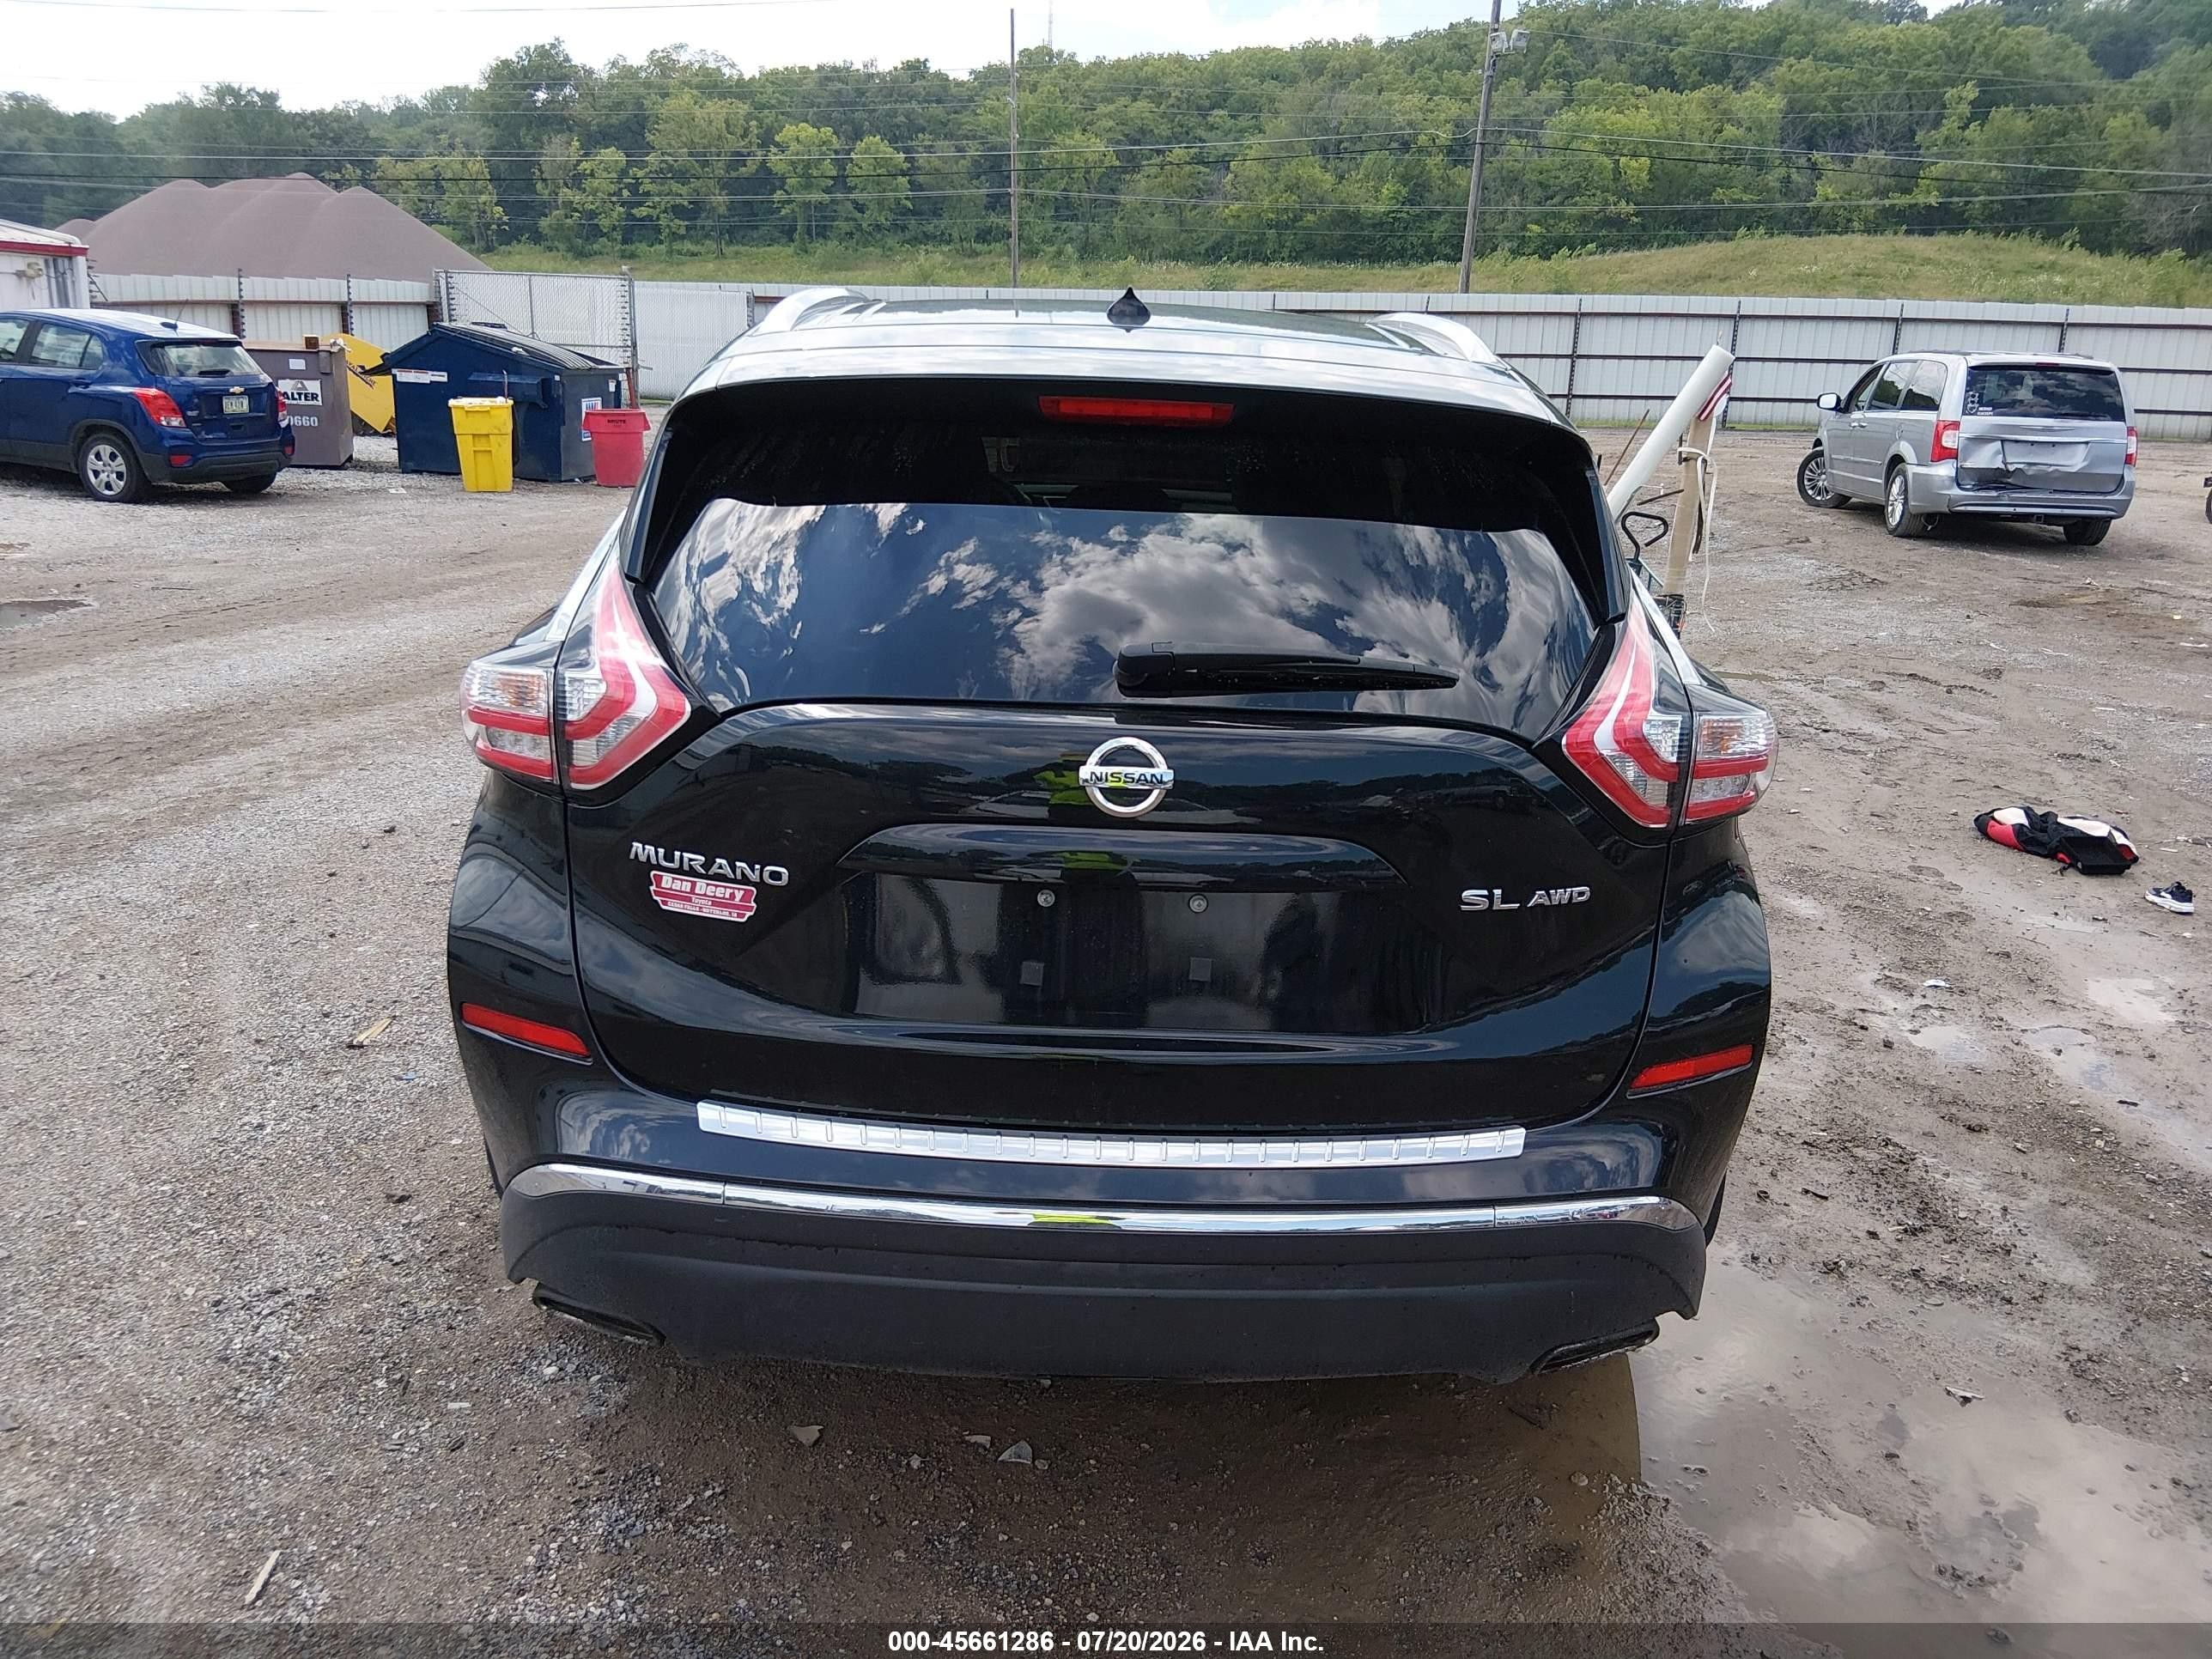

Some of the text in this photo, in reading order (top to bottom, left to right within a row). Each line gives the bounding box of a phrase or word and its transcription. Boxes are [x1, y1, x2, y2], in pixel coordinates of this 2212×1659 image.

[283, 392, 320, 402] ALTER
[1090, 771, 1164, 785] NISSAN
[629, 842, 789, 886] MURANO
[660, 875, 744, 902] Dan Deery
[691, 896, 713, 906] Toyota
[1461, 886, 1591, 911] SL AWD
